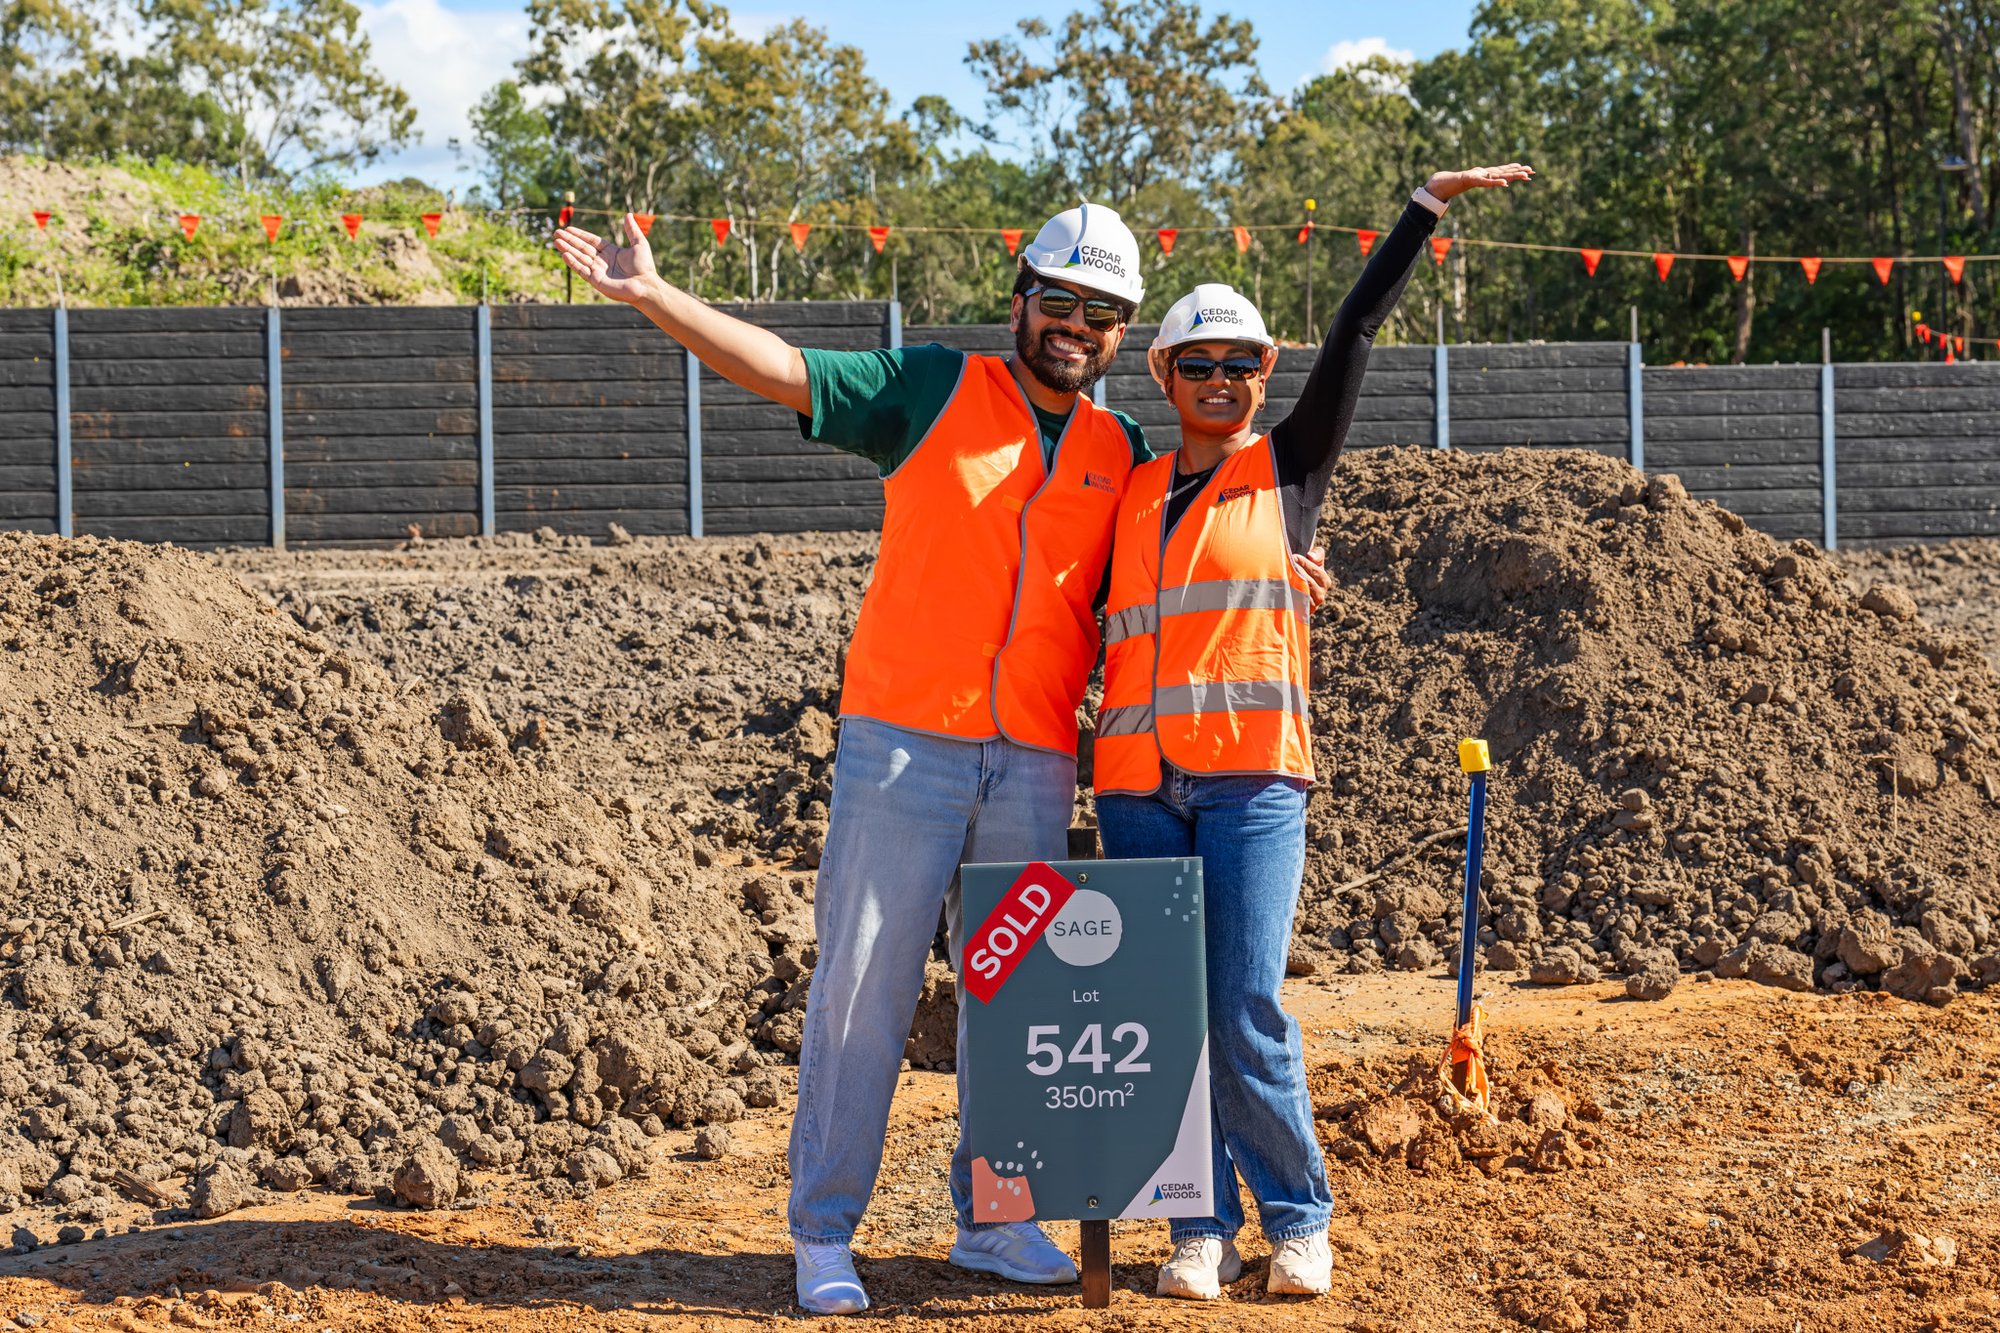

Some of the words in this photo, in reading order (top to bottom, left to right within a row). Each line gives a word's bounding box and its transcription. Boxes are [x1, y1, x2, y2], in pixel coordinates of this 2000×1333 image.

[1081, 245, 1121, 265] CEDAR
[1082, 254, 1126, 278] WOODS
[1201, 308, 1237, 317] CEDAR
[1203, 316, 1244, 326] WOODS
[1088, 472, 1112, 485] CEDAR
[1089, 481, 1116, 494] WOODS
[1222, 484, 1250, 495] CEDAR
[1224, 490, 1256, 500] WOODS
[970, 883, 1052, 980] SOLD
[1053, 919, 1113, 937] SAGE
[1072, 989, 1100, 1003] Lot
[1025, 1022, 1151, 1076] 542
[1045, 1082, 1135, 1109] 350m²
[1161, 1183, 1194, 1191] CEDAR
[1163, 1190, 1201, 1199] WOODS
